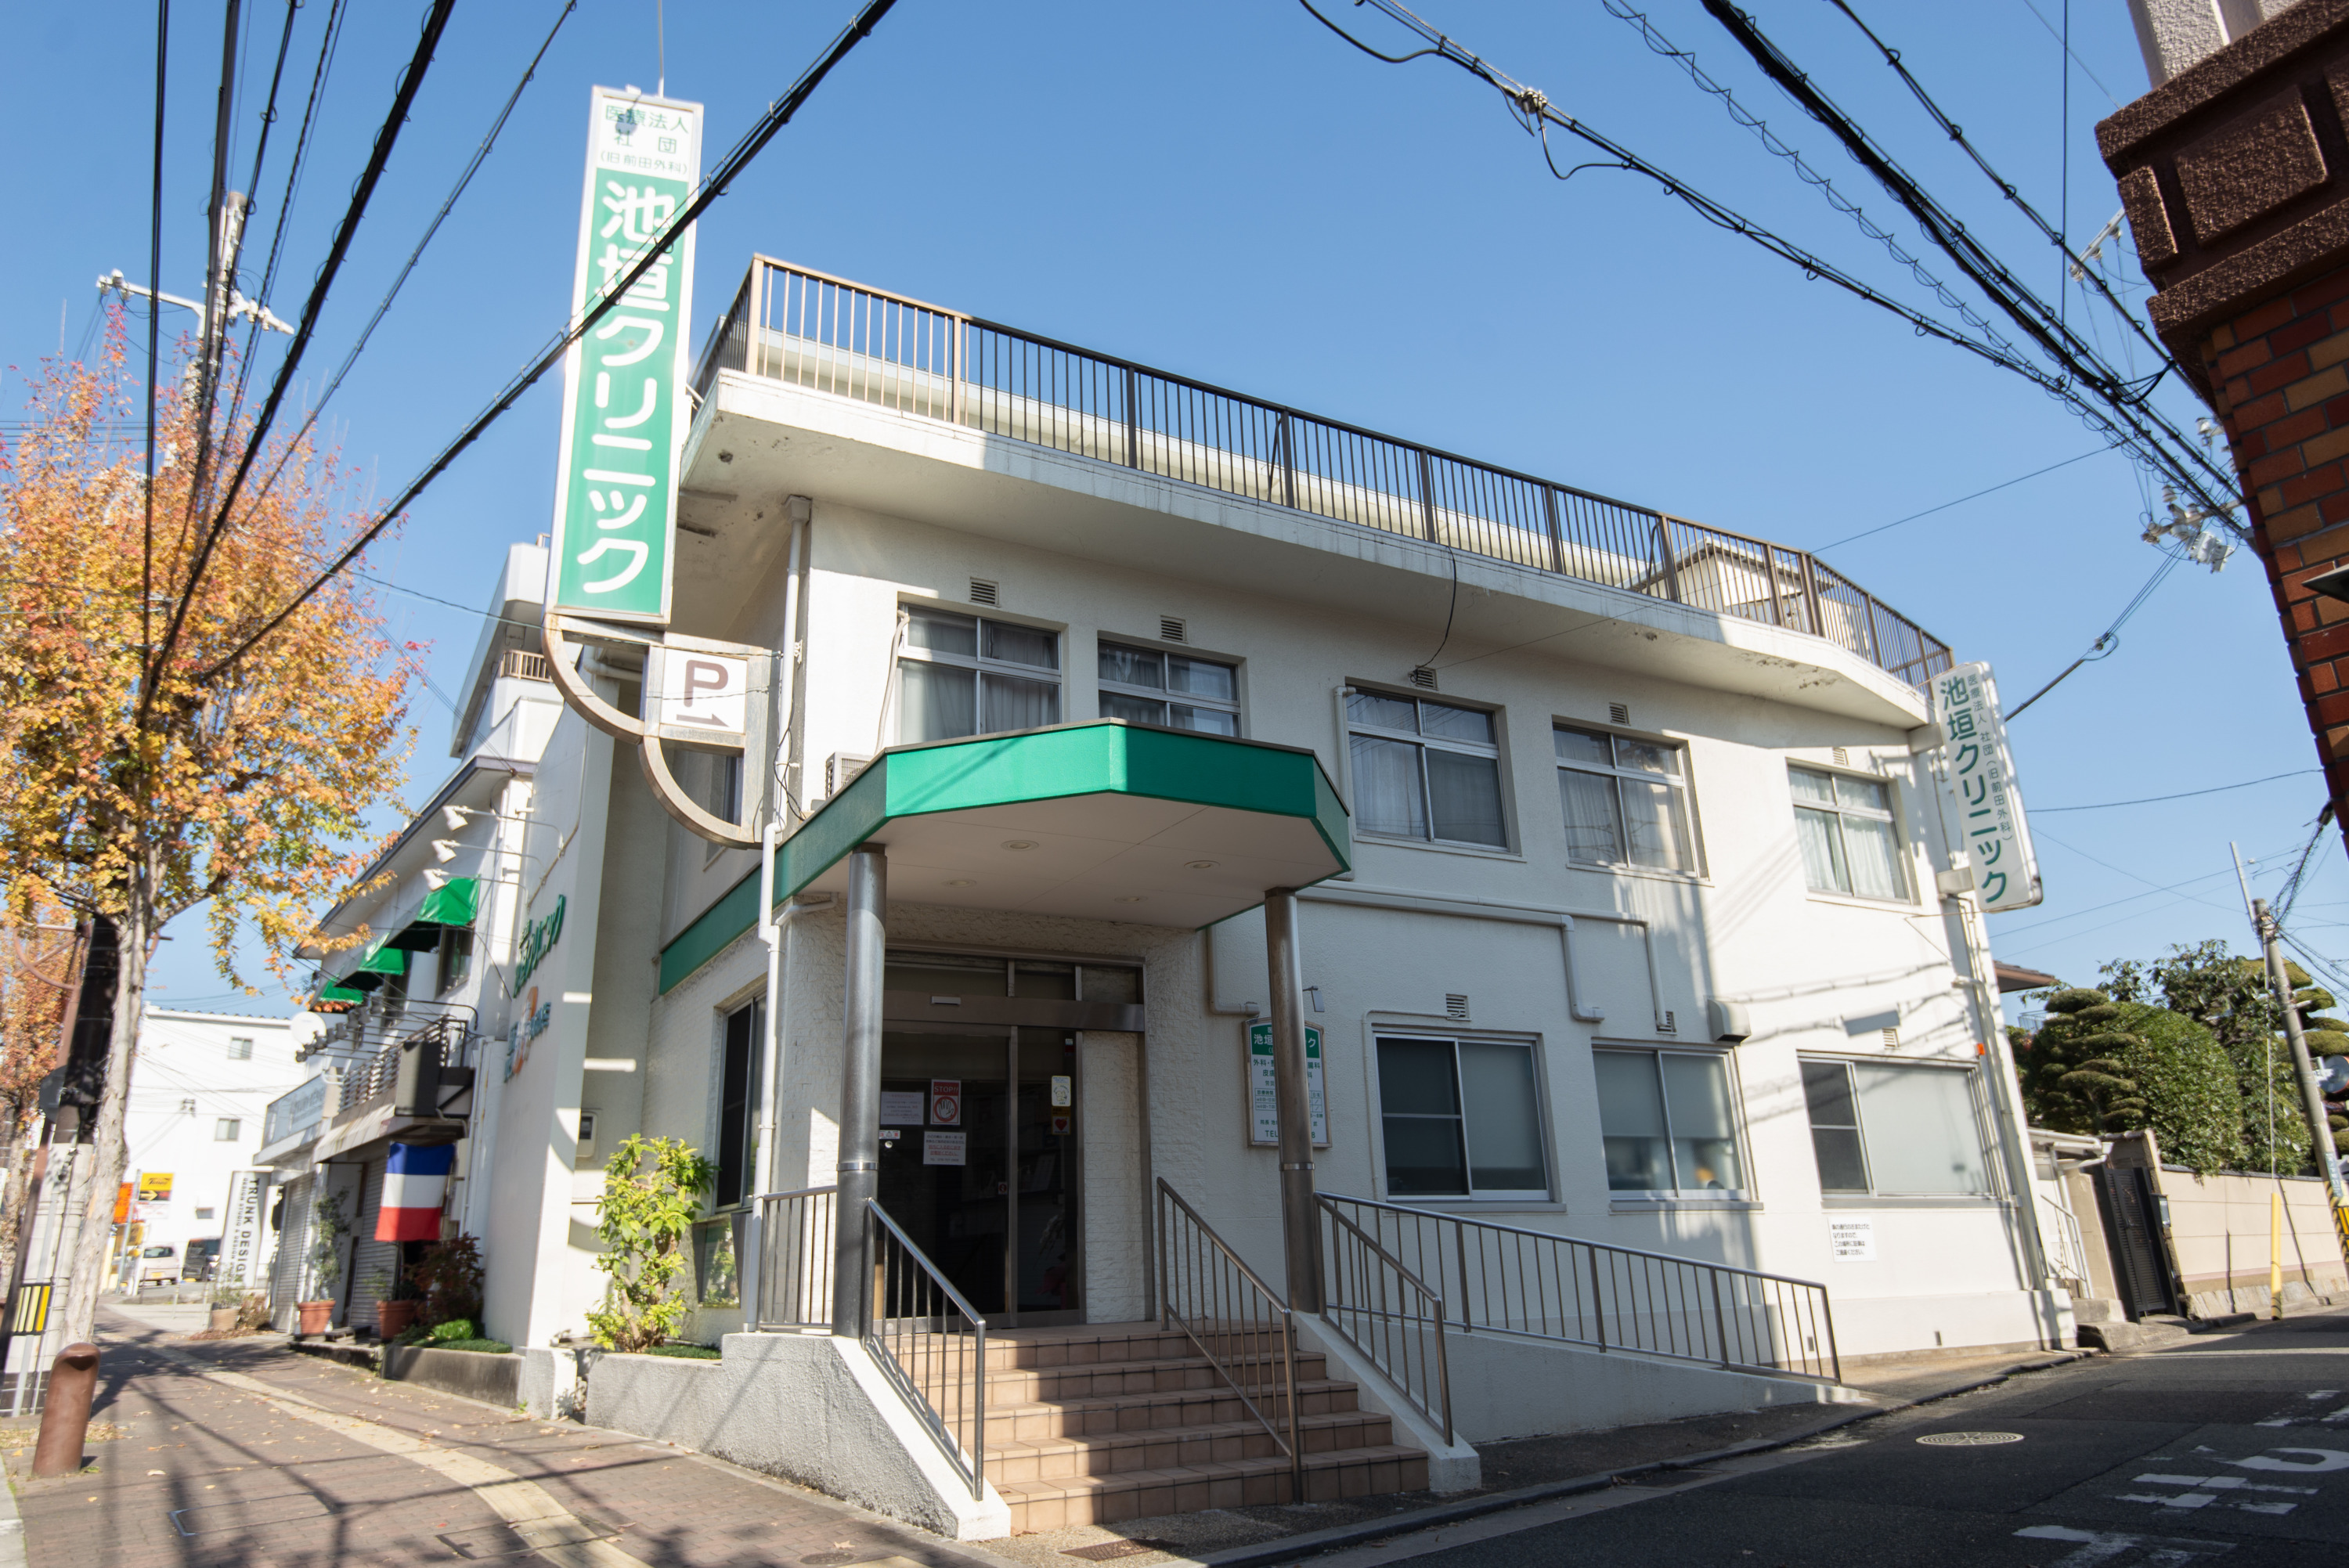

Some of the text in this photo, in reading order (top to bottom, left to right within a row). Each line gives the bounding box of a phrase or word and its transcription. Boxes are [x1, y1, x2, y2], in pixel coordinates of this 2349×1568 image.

[606, 105, 689, 133] 医療法人
[577, 180, 676, 593] 池垣クリニック
[684, 659, 729, 708] P
[1939, 676, 2007, 904] 池垣クリニック
[243, 1177, 261, 1224] TRUNK
